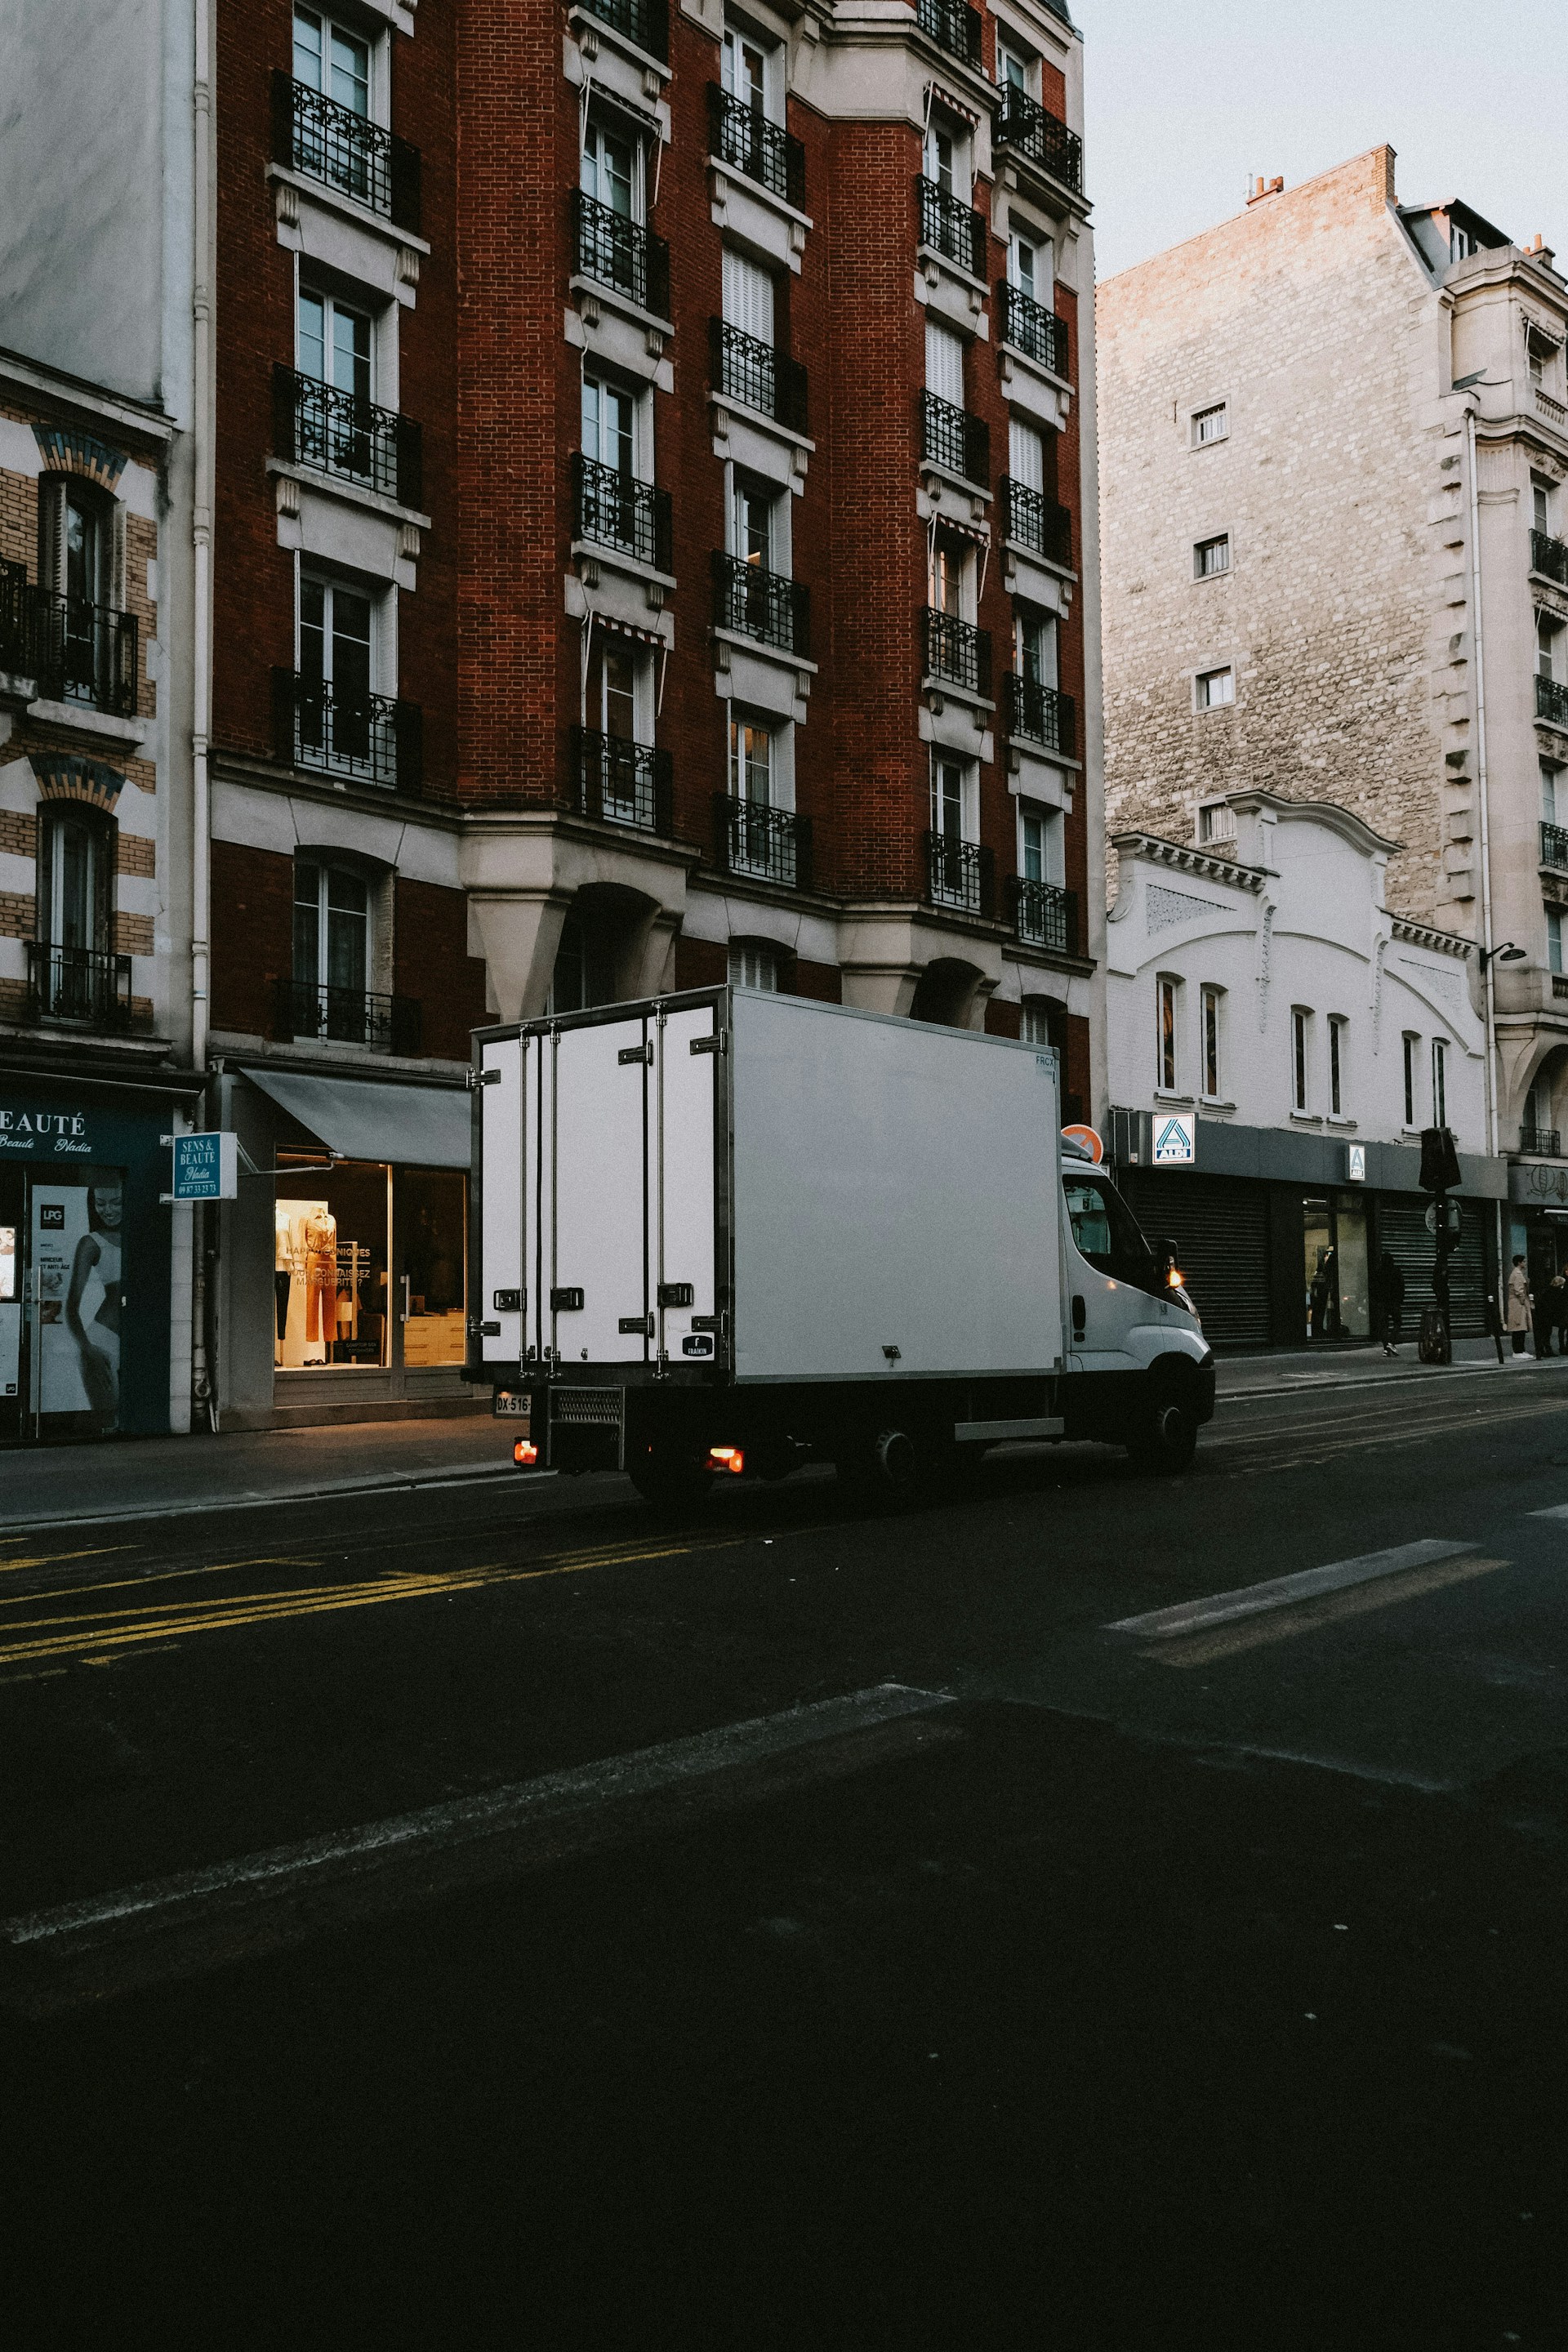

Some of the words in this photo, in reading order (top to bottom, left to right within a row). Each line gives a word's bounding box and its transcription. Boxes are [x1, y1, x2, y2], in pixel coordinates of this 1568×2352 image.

[1036, 1055, 1054, 1067] FRCX
[54, 1138, 91, 1152] Nadia
[182, 1140, 204, 1152] SENS
[206, 1138, 214, 1152] &
[1157, 1148, 1190, 1159] ALDI
[185, 1166, 210, 1181] Nadia
[43, 1210, 63, 1220] LPG
